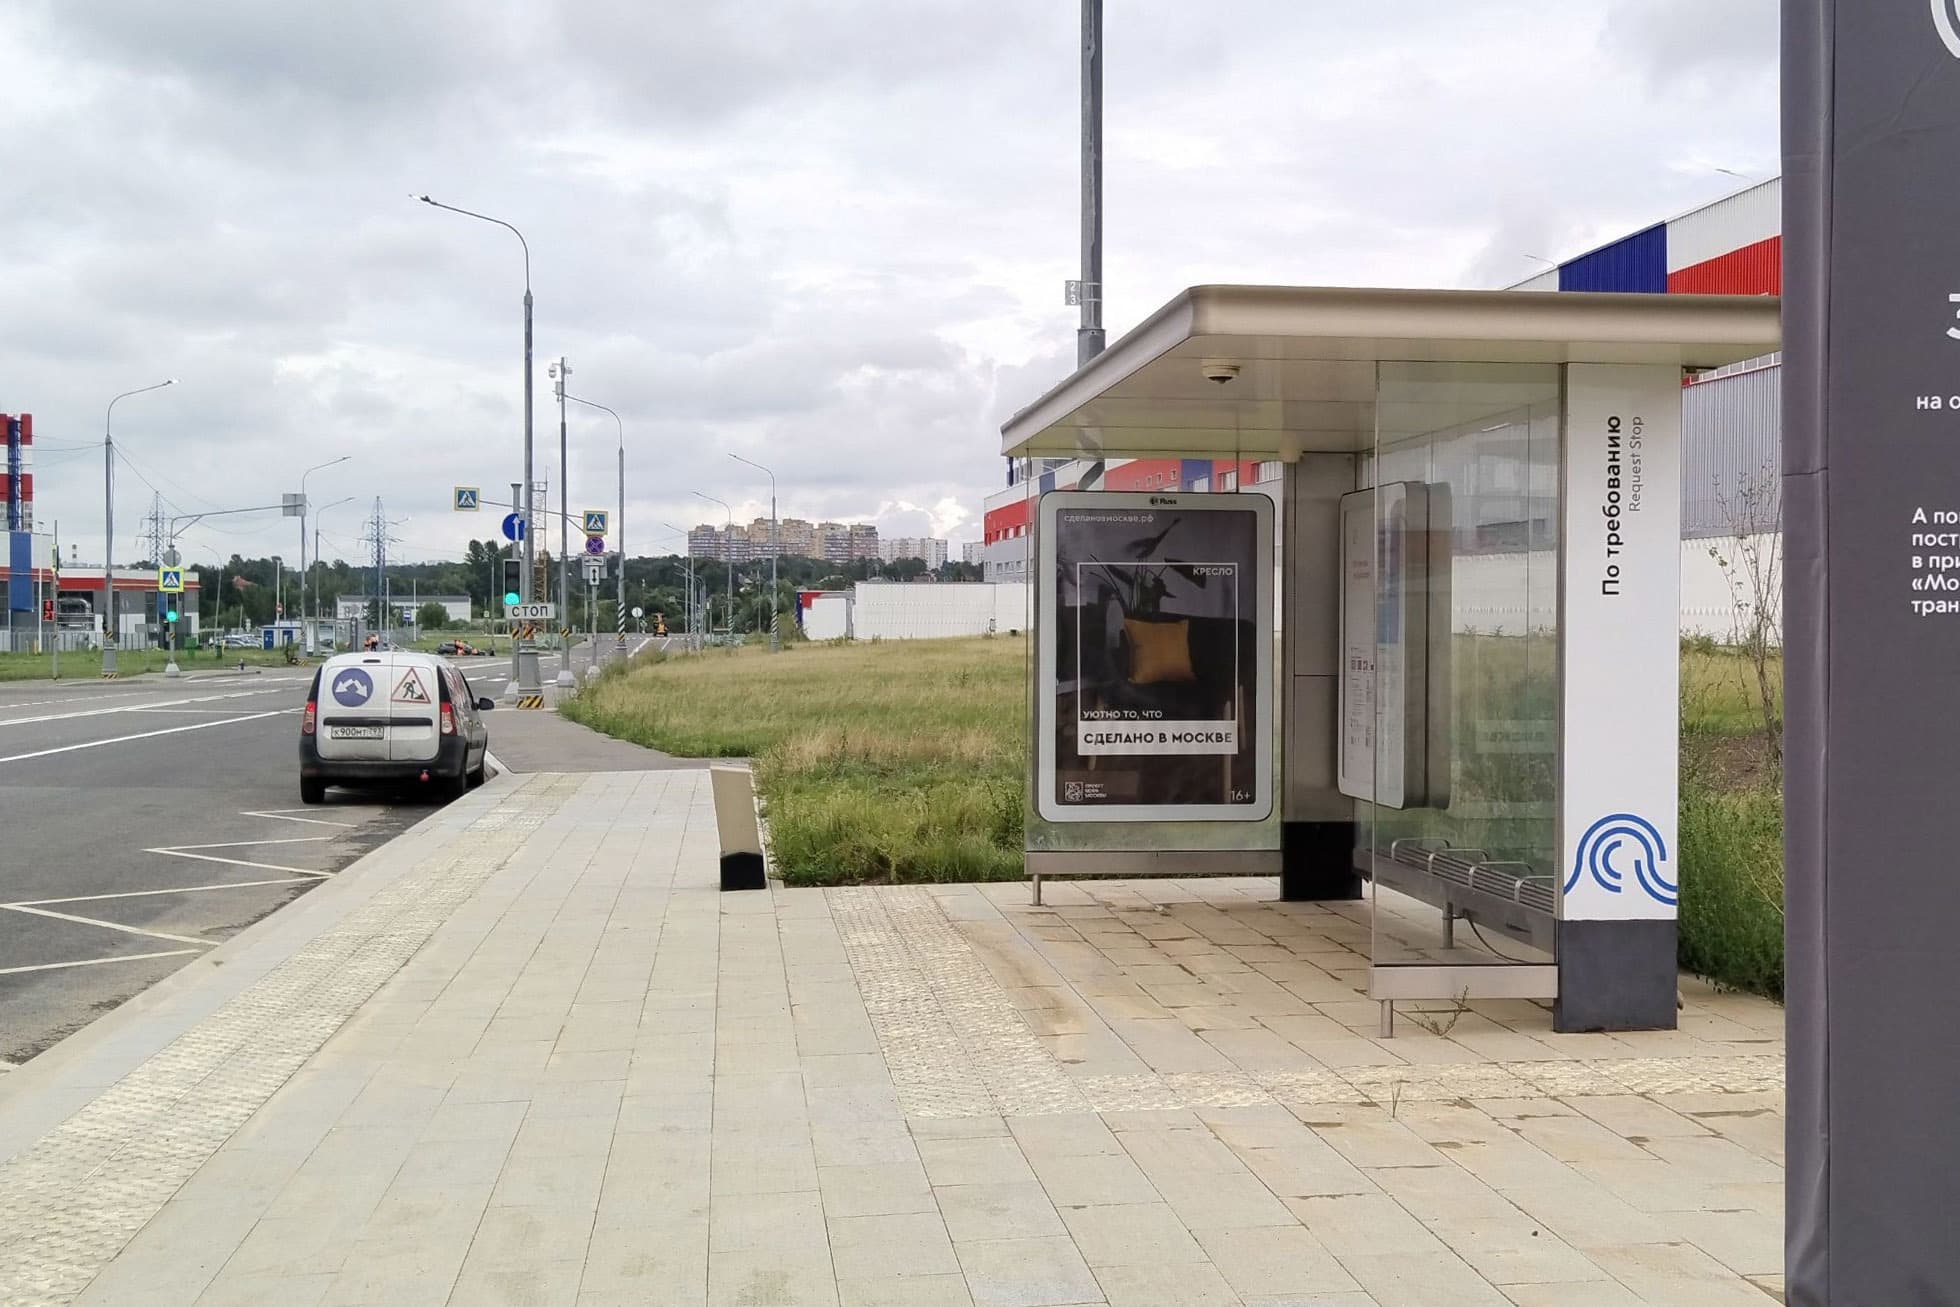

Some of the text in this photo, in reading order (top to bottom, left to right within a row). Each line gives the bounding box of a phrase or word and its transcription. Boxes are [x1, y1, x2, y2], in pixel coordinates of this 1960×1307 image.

[1917, 395, 1942, 409] на
[1629, 416, 1645, 512] Request Stop
[1602, 415, 1624, 595] По требованию
[1911, 507, 1960, 524] А по
[1912, 533, 1960, 549] пост
[1912, 556, 1923, 568] в
[1193, 567, 1233, 576] КРЕСЛО
[512, 605, 548, 617] СТОП
[1911, 600, 1960, 617] тран
[1083, 710, 1163, 720] УЮТНО ТО, ЧТО
[1084, 732, 1233, 746] СДЕЛАНО В МОСКВЕ
[1231, 790, 1251, 801] 16+
